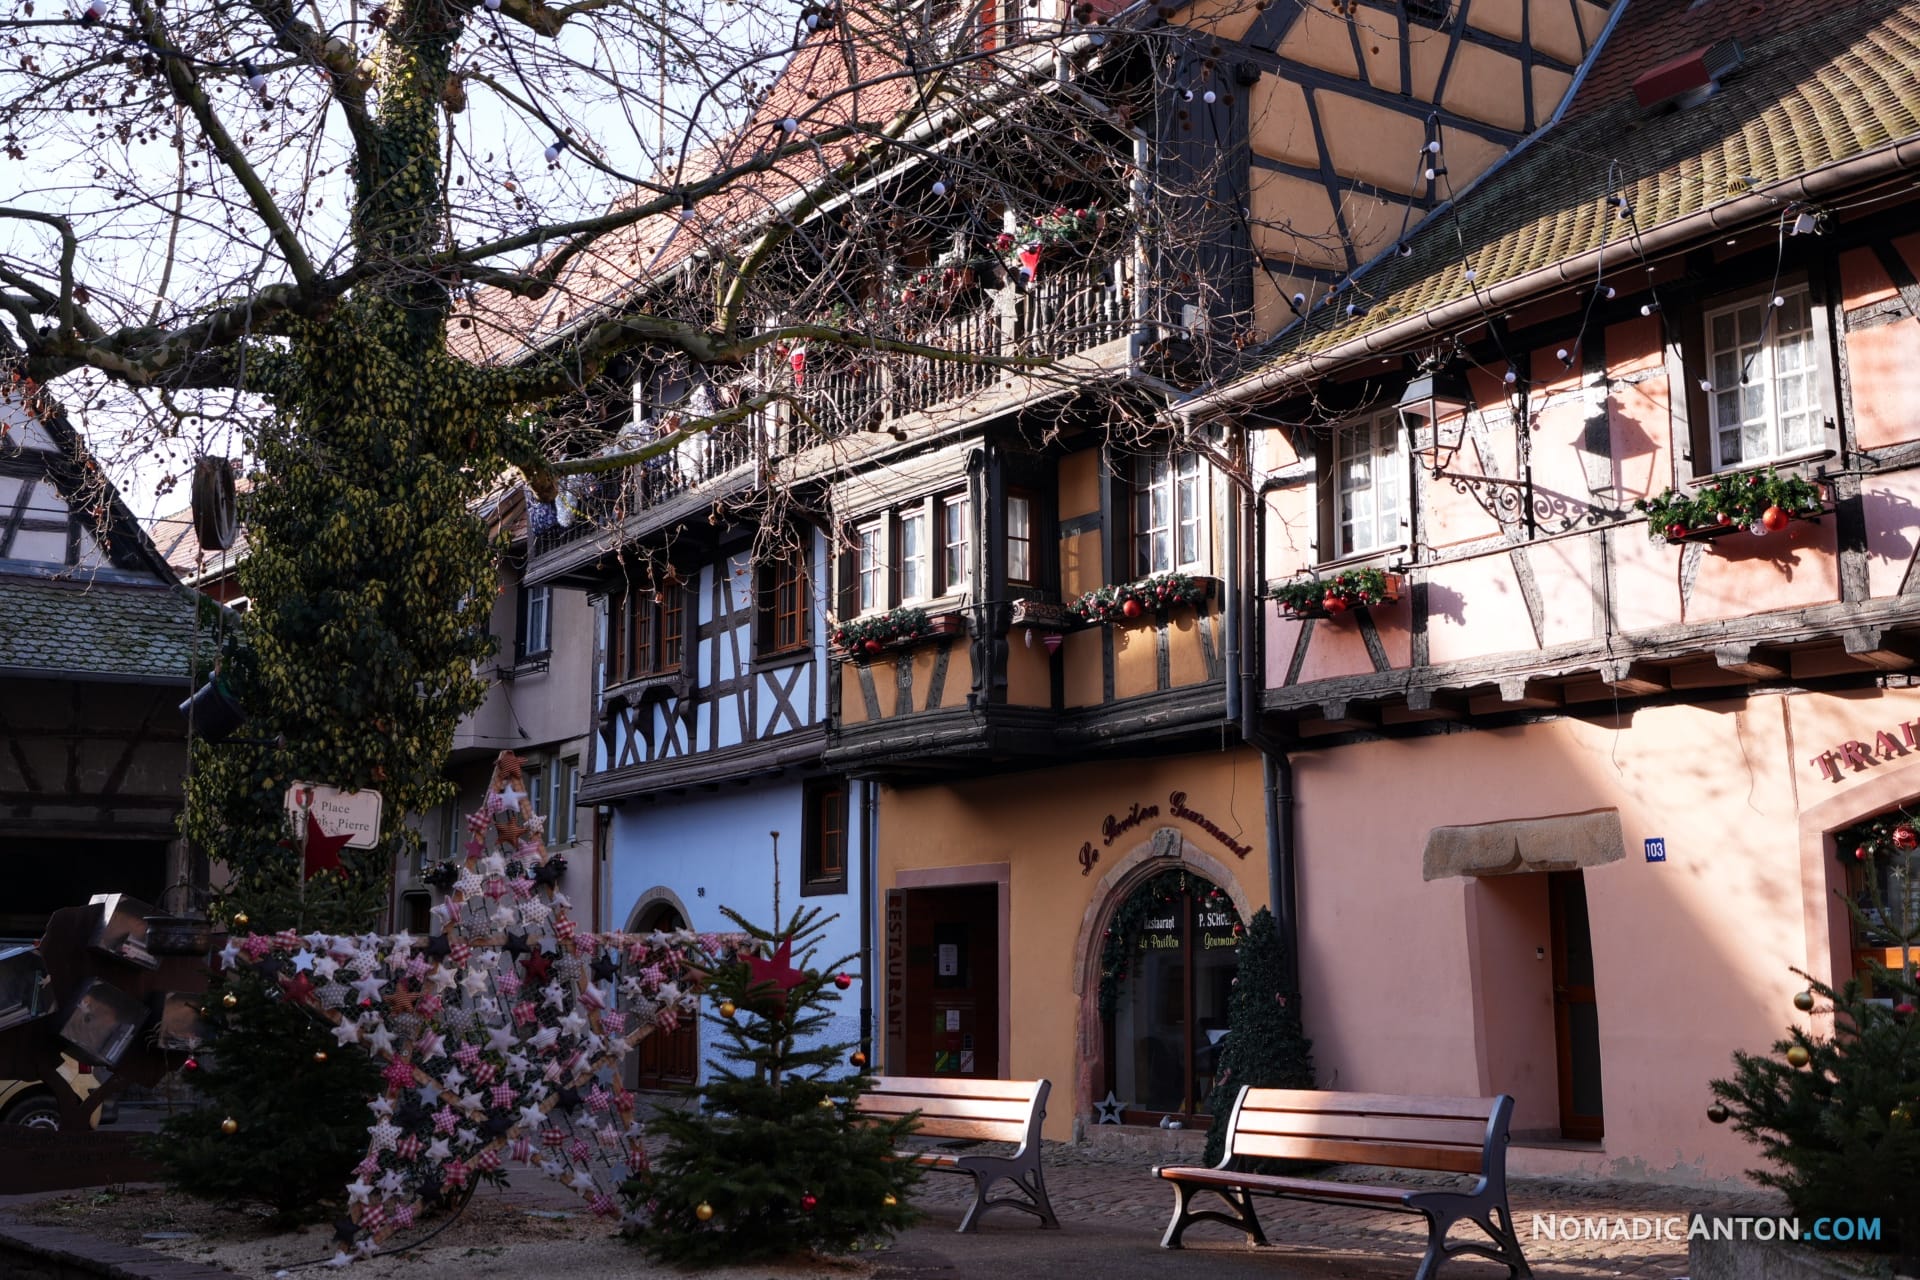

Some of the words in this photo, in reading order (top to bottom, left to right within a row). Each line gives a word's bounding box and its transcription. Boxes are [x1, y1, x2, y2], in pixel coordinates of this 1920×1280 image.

[1809, 716, 1920, 781] TRAI
[321, 800, 351, 814] Place
[338, 818, 370, 831] Pierre
[1079, 841, 1099, 876] Le
[1645, 842, 1664, 858] 103
[1151, 934, 1179, 948] Pavillon
[1204, 932, 1236, 949] Gourman
[888, 895, 902, 1039] RESTAURANT
